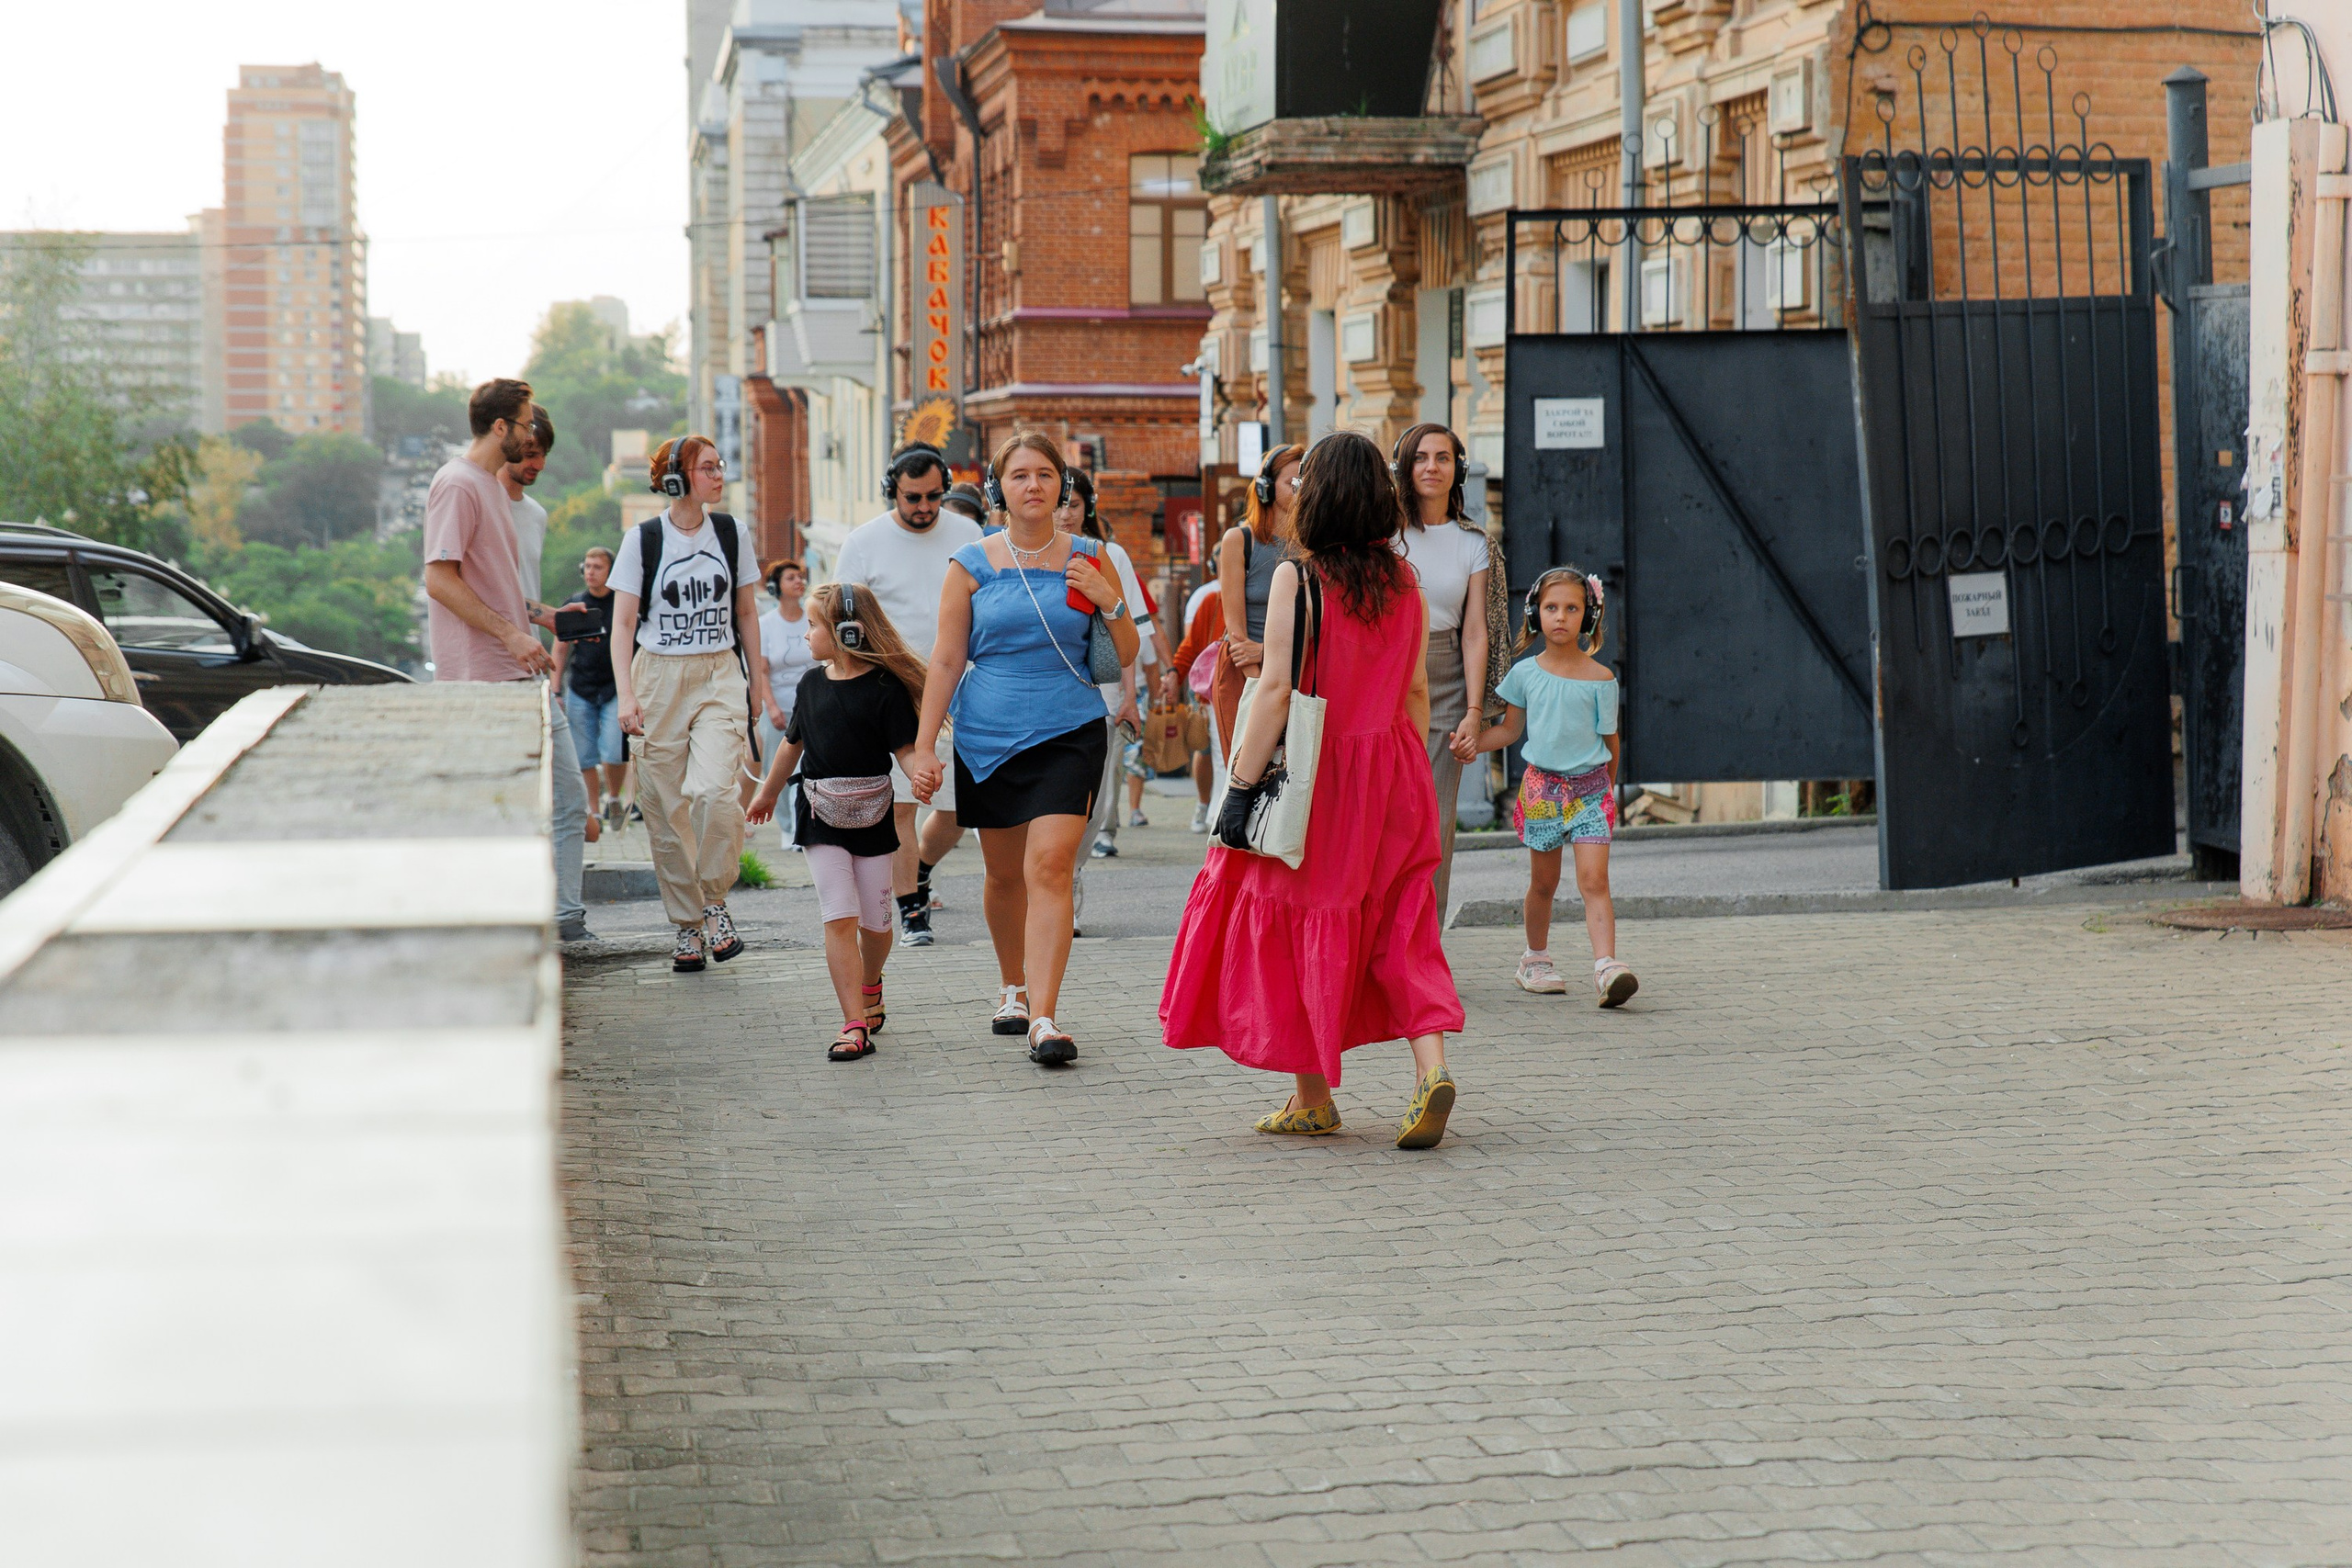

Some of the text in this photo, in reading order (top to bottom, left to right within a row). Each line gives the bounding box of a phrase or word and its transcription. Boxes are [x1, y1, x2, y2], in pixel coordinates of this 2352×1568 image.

[927, 206, 949, 390] КАБАЧОК
[1951, 590, 2002, 603] ПОЖАРНЫЙ
[659, 606, 729, 631] ГОЛОС
[1966, 607, 1991, 616] ЗАЕЗД
